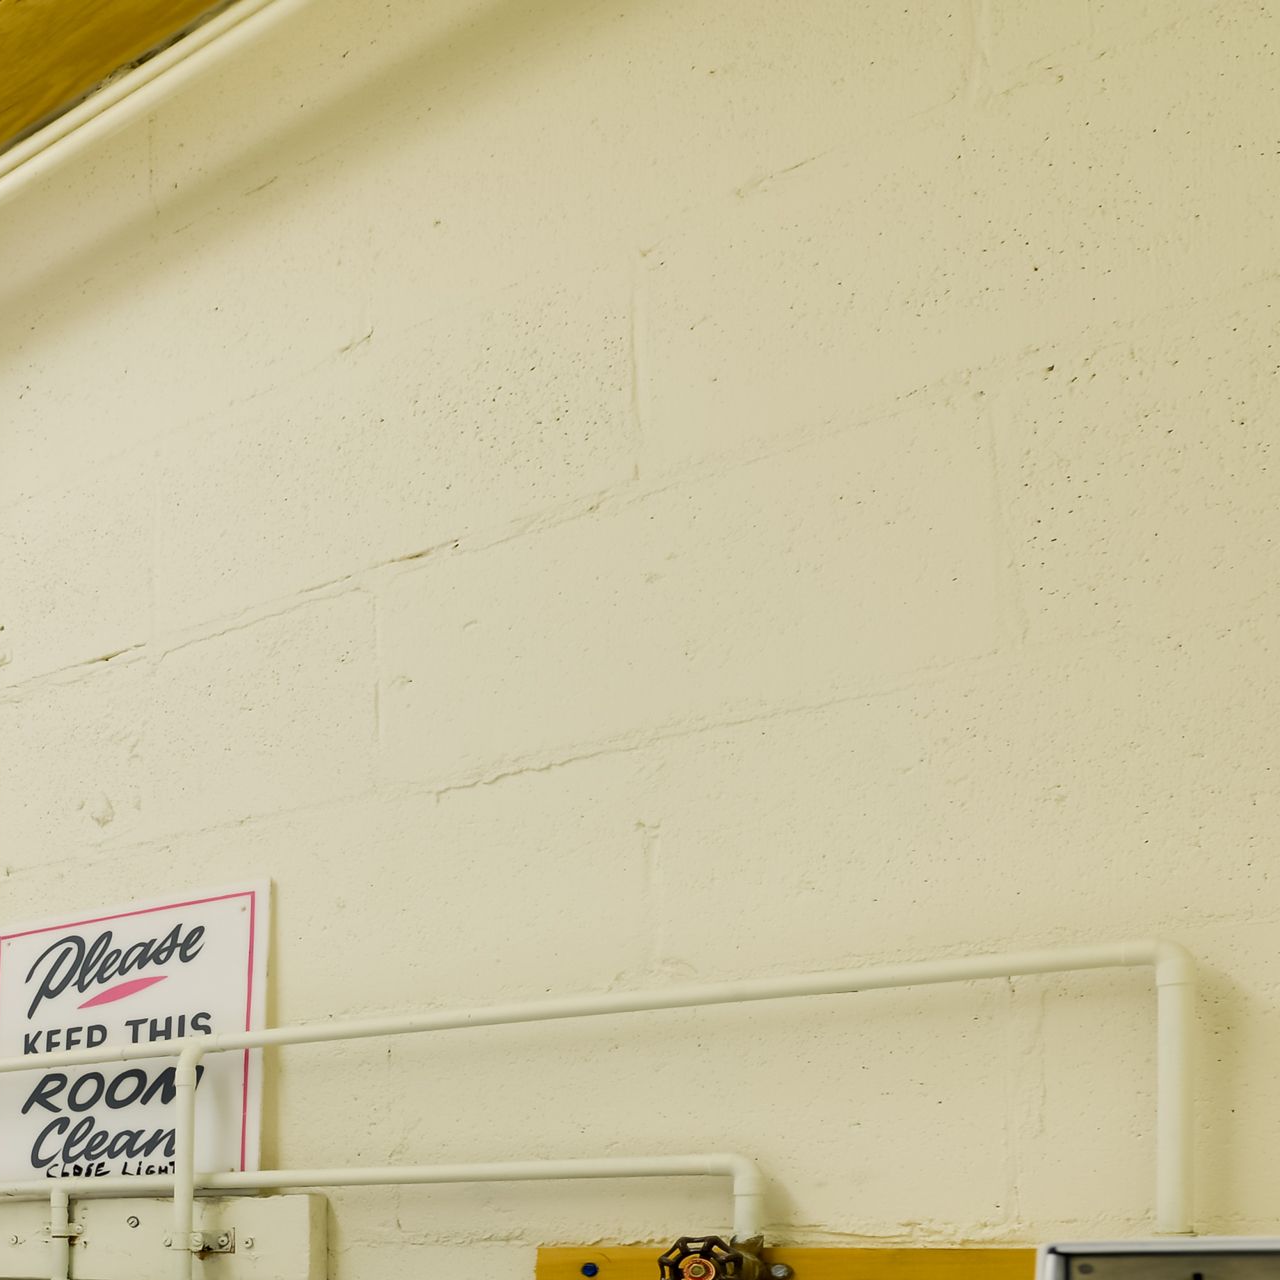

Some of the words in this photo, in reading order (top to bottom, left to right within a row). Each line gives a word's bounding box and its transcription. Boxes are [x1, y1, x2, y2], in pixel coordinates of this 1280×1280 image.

[25, 923, 206, 1020] Please
[124, 1012, 212, 1044] THIS
[31, 1115, 175, 1168] Clean
